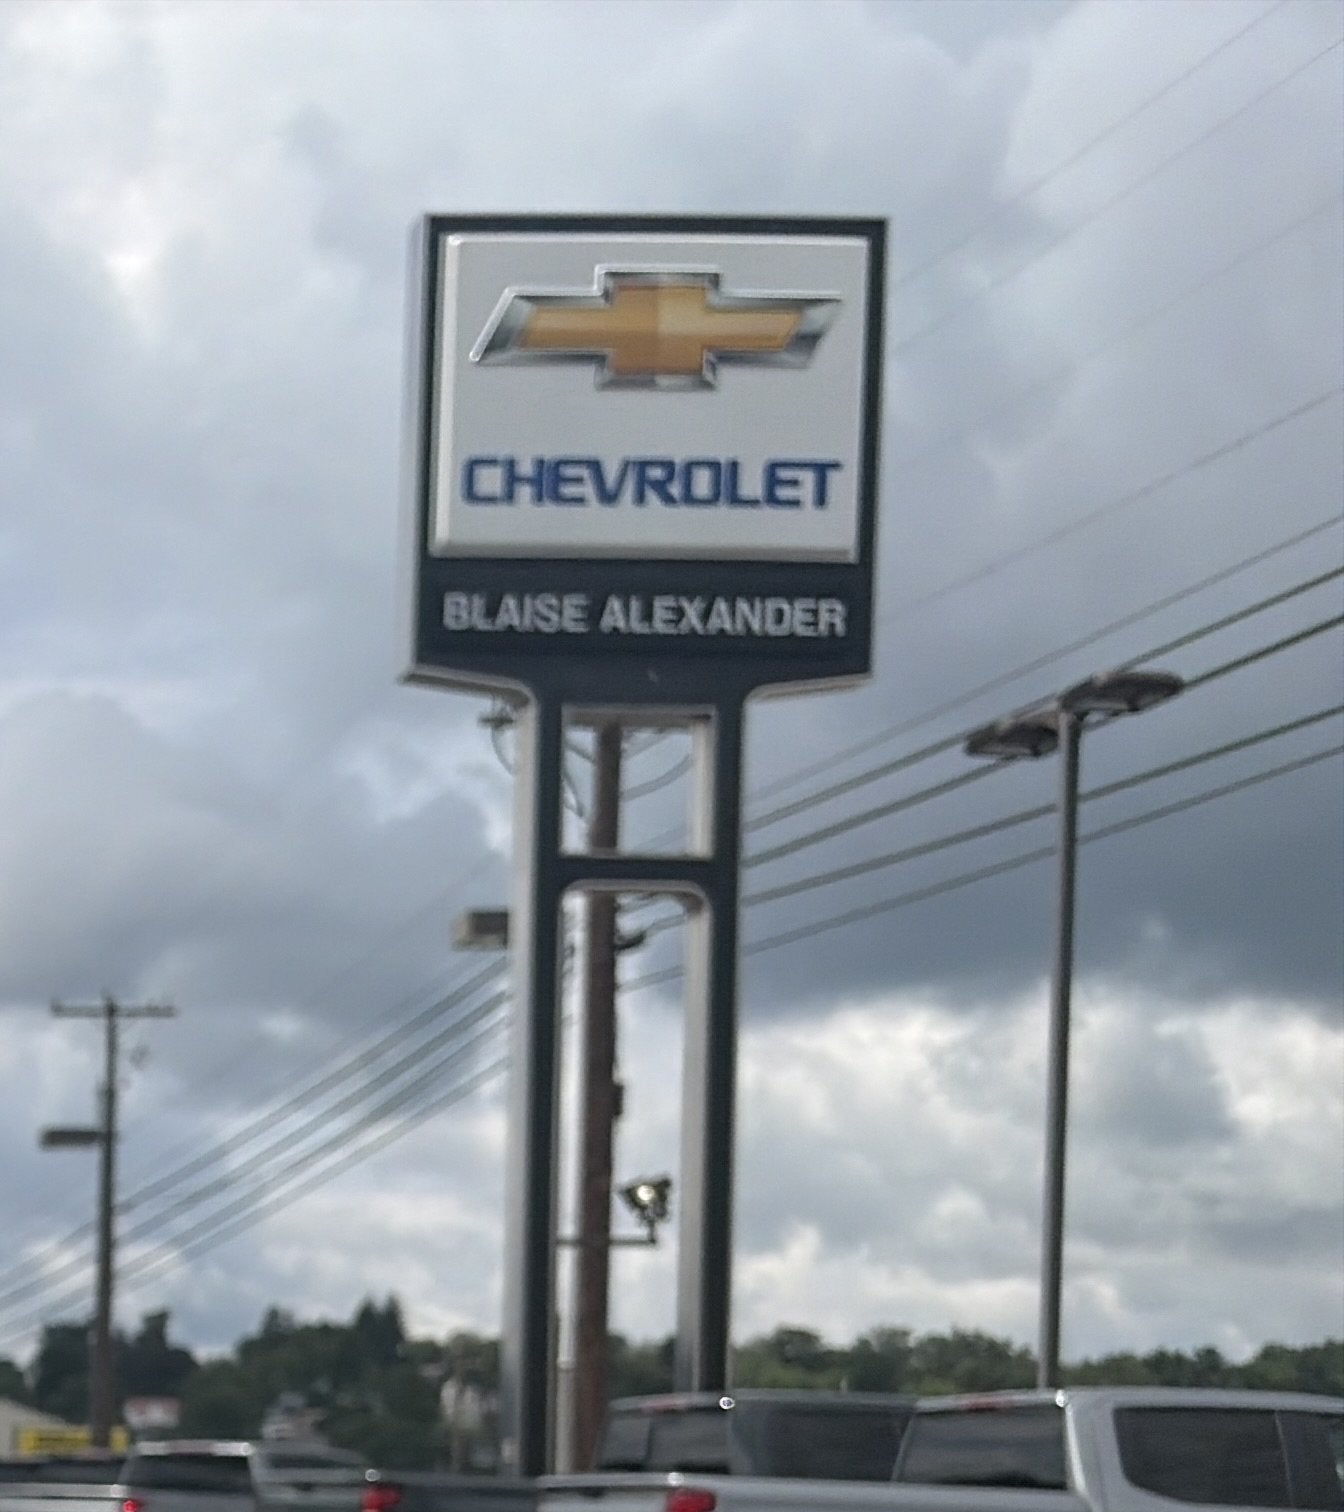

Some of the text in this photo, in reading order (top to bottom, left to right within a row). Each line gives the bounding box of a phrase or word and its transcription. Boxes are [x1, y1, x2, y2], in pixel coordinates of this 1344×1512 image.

[461, 456, 843, 509] CHEVROLET
[442, 591, 848, 638] BLAISE ALEXANDER
